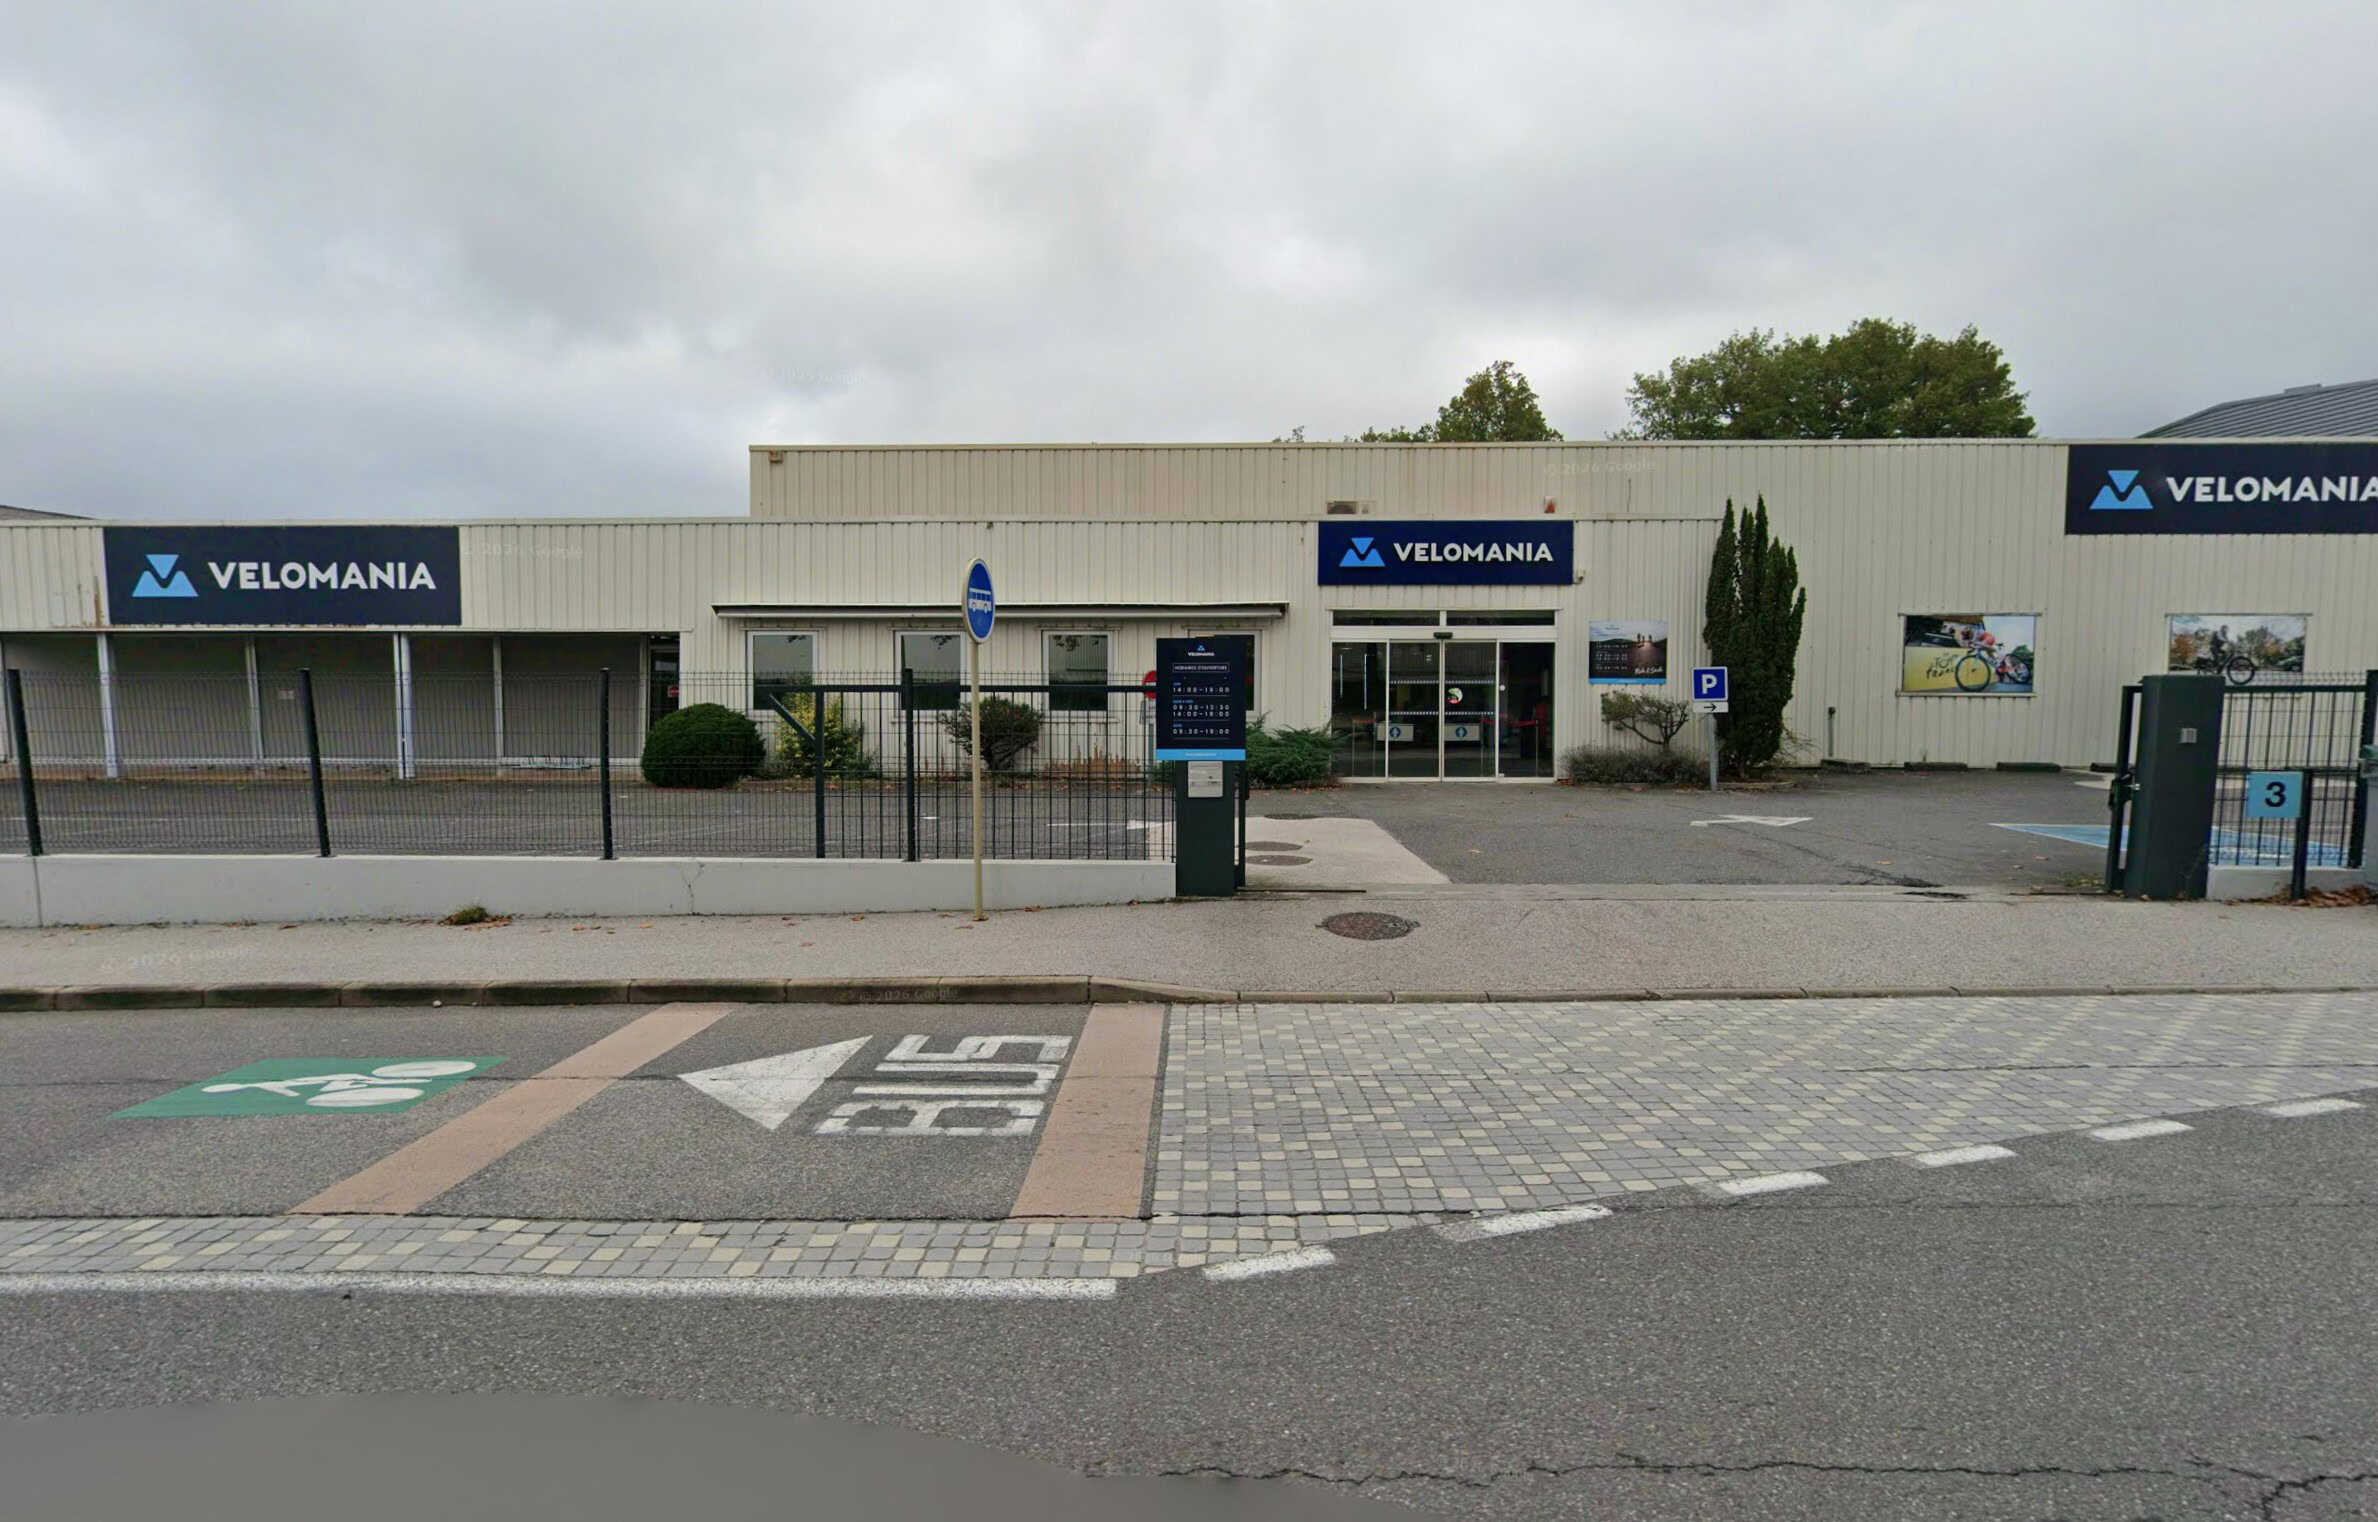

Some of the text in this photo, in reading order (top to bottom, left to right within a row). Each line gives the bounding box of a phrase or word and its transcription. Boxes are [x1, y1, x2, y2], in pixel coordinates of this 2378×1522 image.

[2167, 476, 2378, 502] VELOMANIA
[1393, 543, 1553, 562] VELOMANIA
[208, 561, 436, 590] VELOMANIA
[1702, 674, 1718, 695] P
[2264, 781, 2287, 808] 3
[812, 1034, 1073, 1137] BUS
